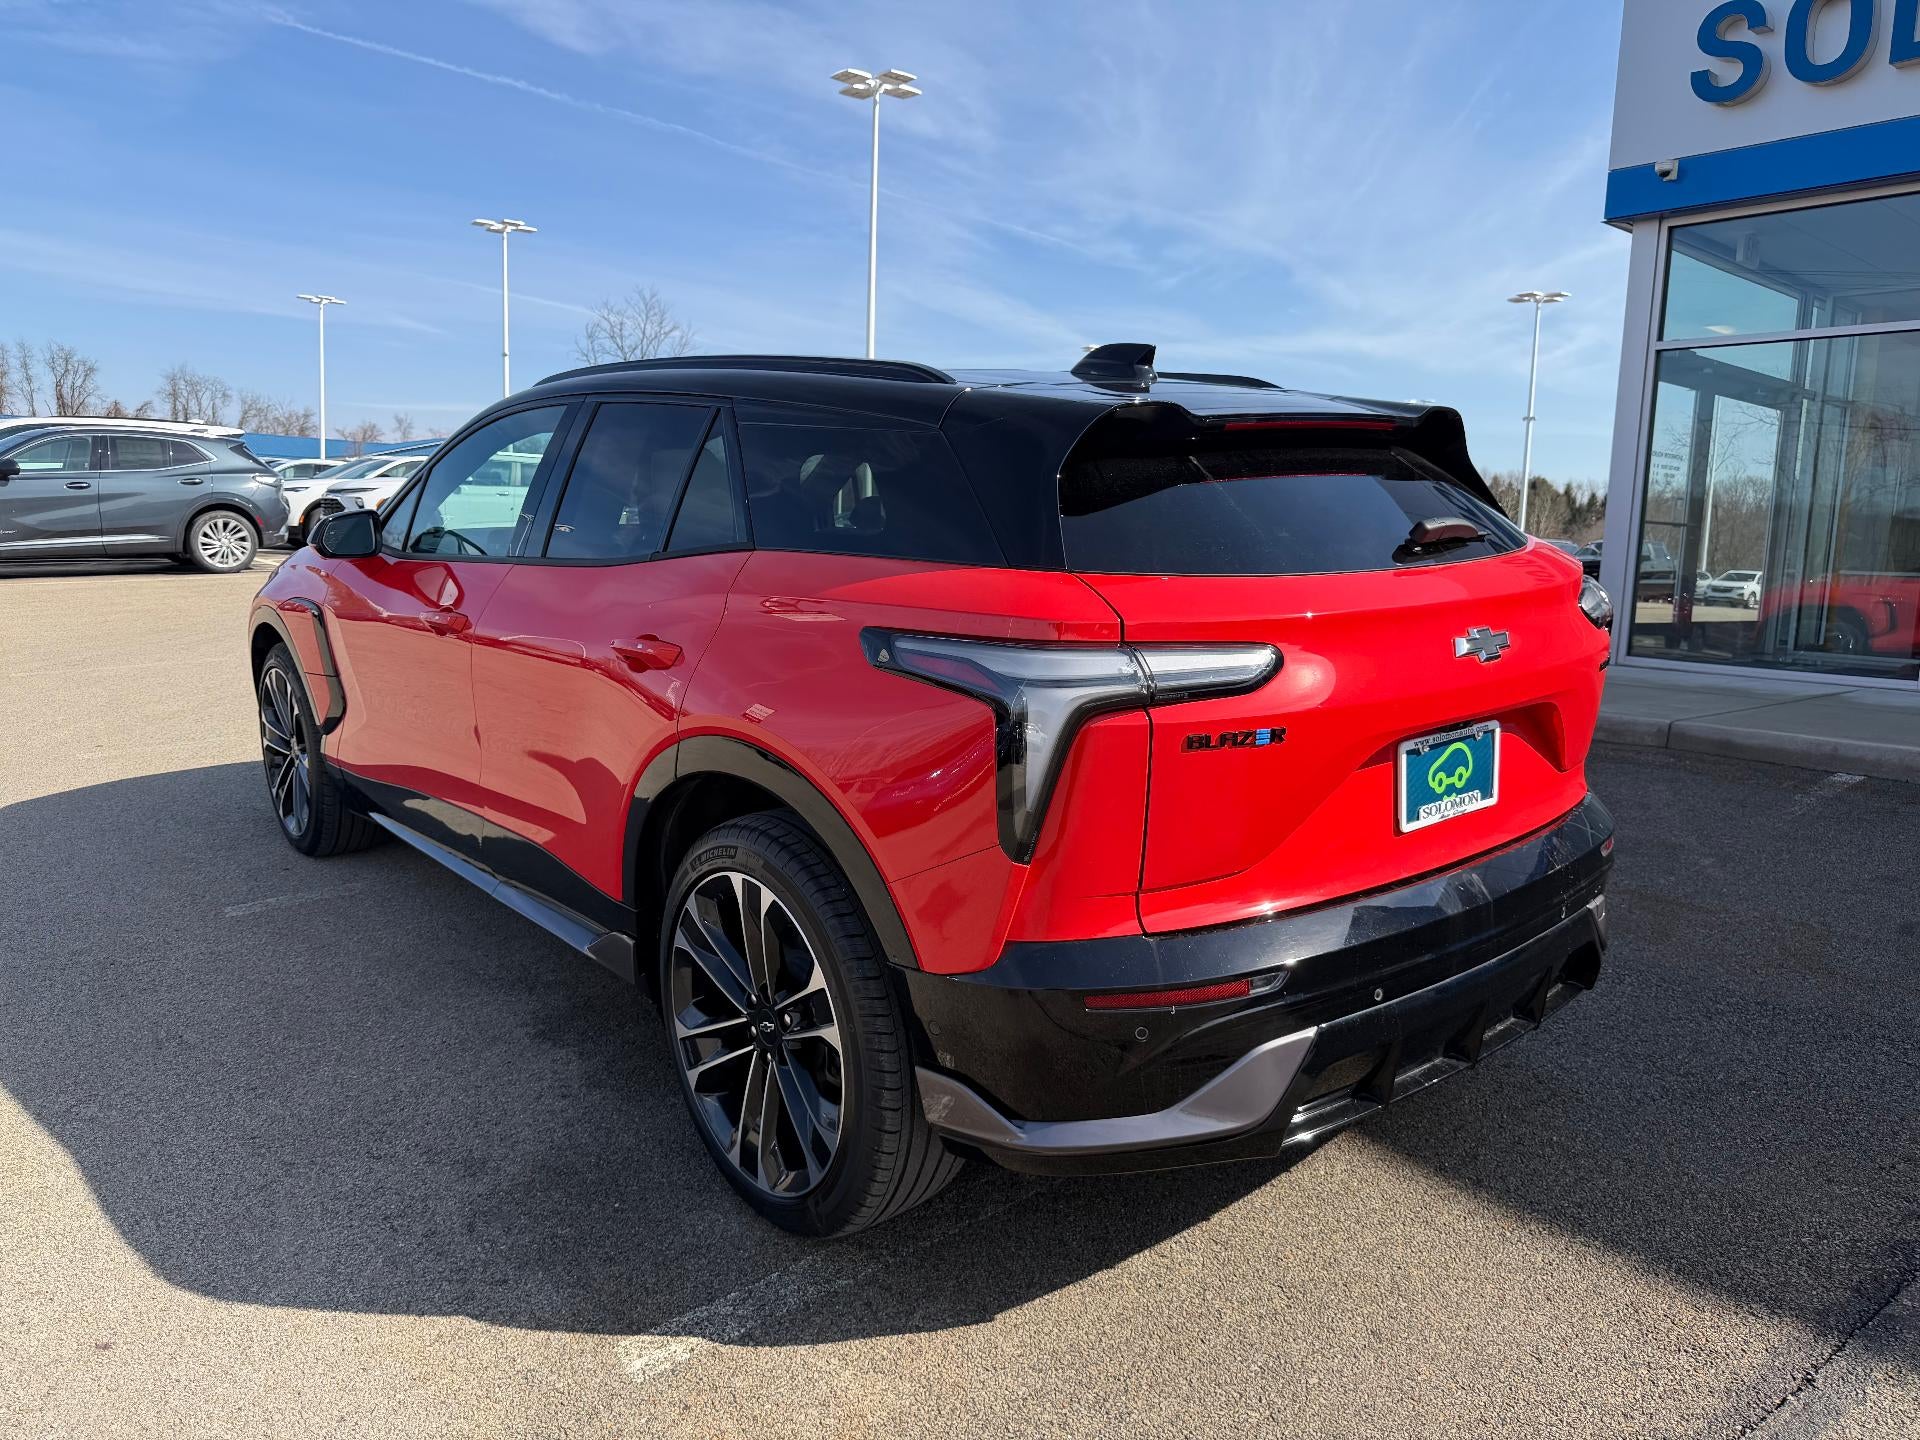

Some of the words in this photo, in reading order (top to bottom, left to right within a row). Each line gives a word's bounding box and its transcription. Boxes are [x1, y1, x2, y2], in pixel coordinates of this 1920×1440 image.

[1182, 727, 1287, 753] BLAZER
[1414, 725, 1489, 747] www.solomonauto.com
[1422, 792, 1480, 820] SOLOMON
[701, 848, 736, 860] MICHELIN
